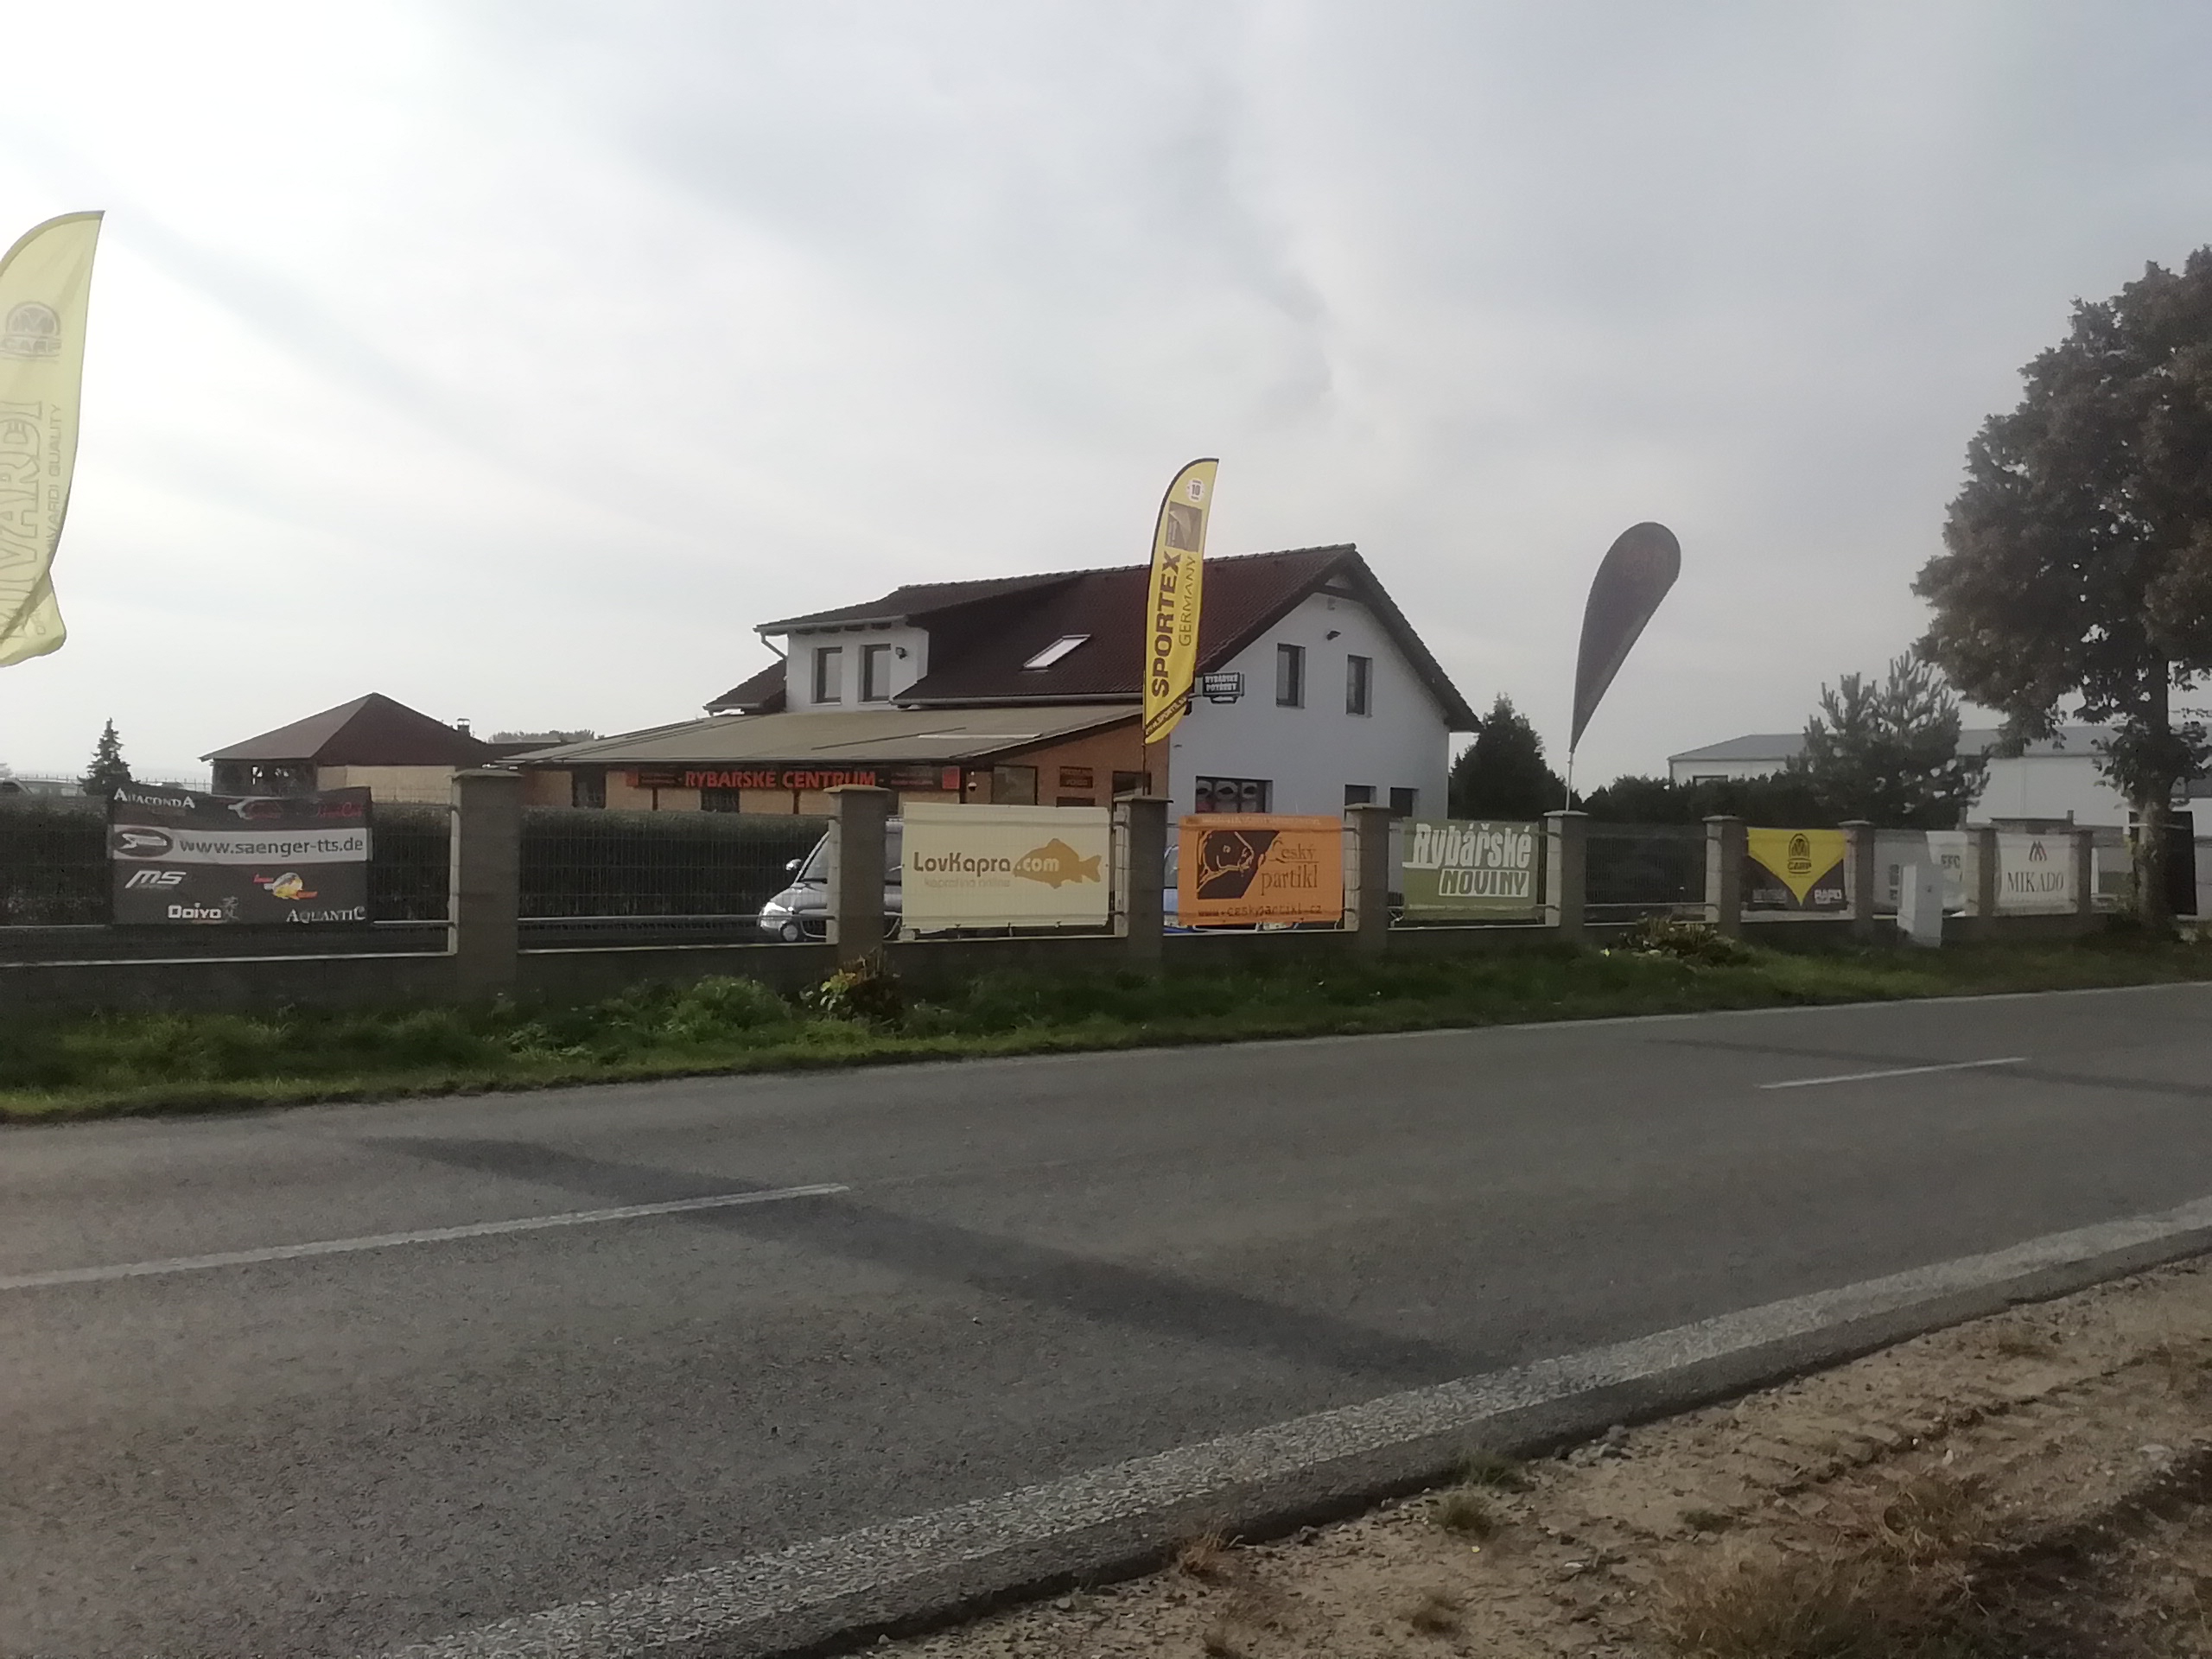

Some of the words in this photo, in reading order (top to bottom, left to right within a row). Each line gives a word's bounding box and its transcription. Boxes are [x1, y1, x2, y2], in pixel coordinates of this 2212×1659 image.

[48, 404, 61, 477] QUALITY
[1178, 556, 1197, 646] GERMANY
[1151, 550, 1181, 698] SPORTEX
[782, 771, 876, 788] CENTRUM
[180, 836, 364, 858] www.saenger-tts.de
[1413, 823, 1532, 868] Rybářské
[124, 870, 187, 889] MS
[1261, 864, 1318, 896] partikl
[1441, 870, 1527, 895] NOVINY
[2007, 871, 2064, 893] MIKADO
